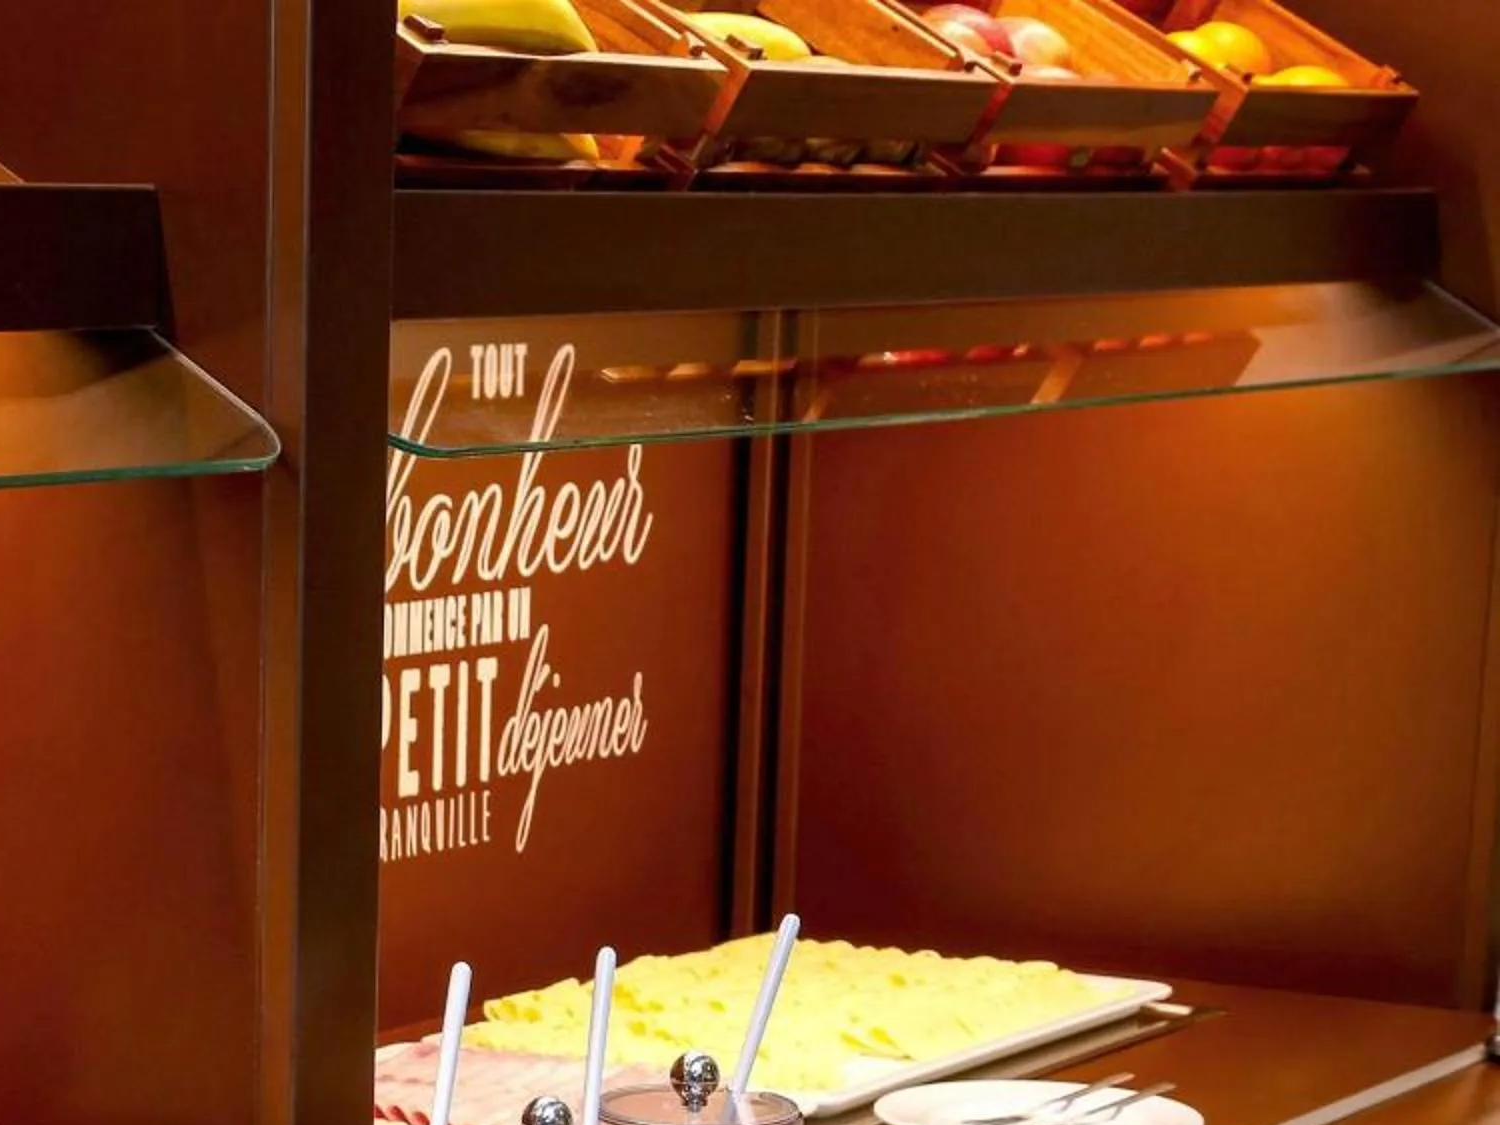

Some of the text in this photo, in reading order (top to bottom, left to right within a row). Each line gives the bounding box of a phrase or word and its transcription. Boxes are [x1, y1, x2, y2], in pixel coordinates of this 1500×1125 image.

[470, 343, 528, 399] TOUT
[384, 595, 467, 660] OMMENCE
[379, 789, 491, 863] RANQUILLE
